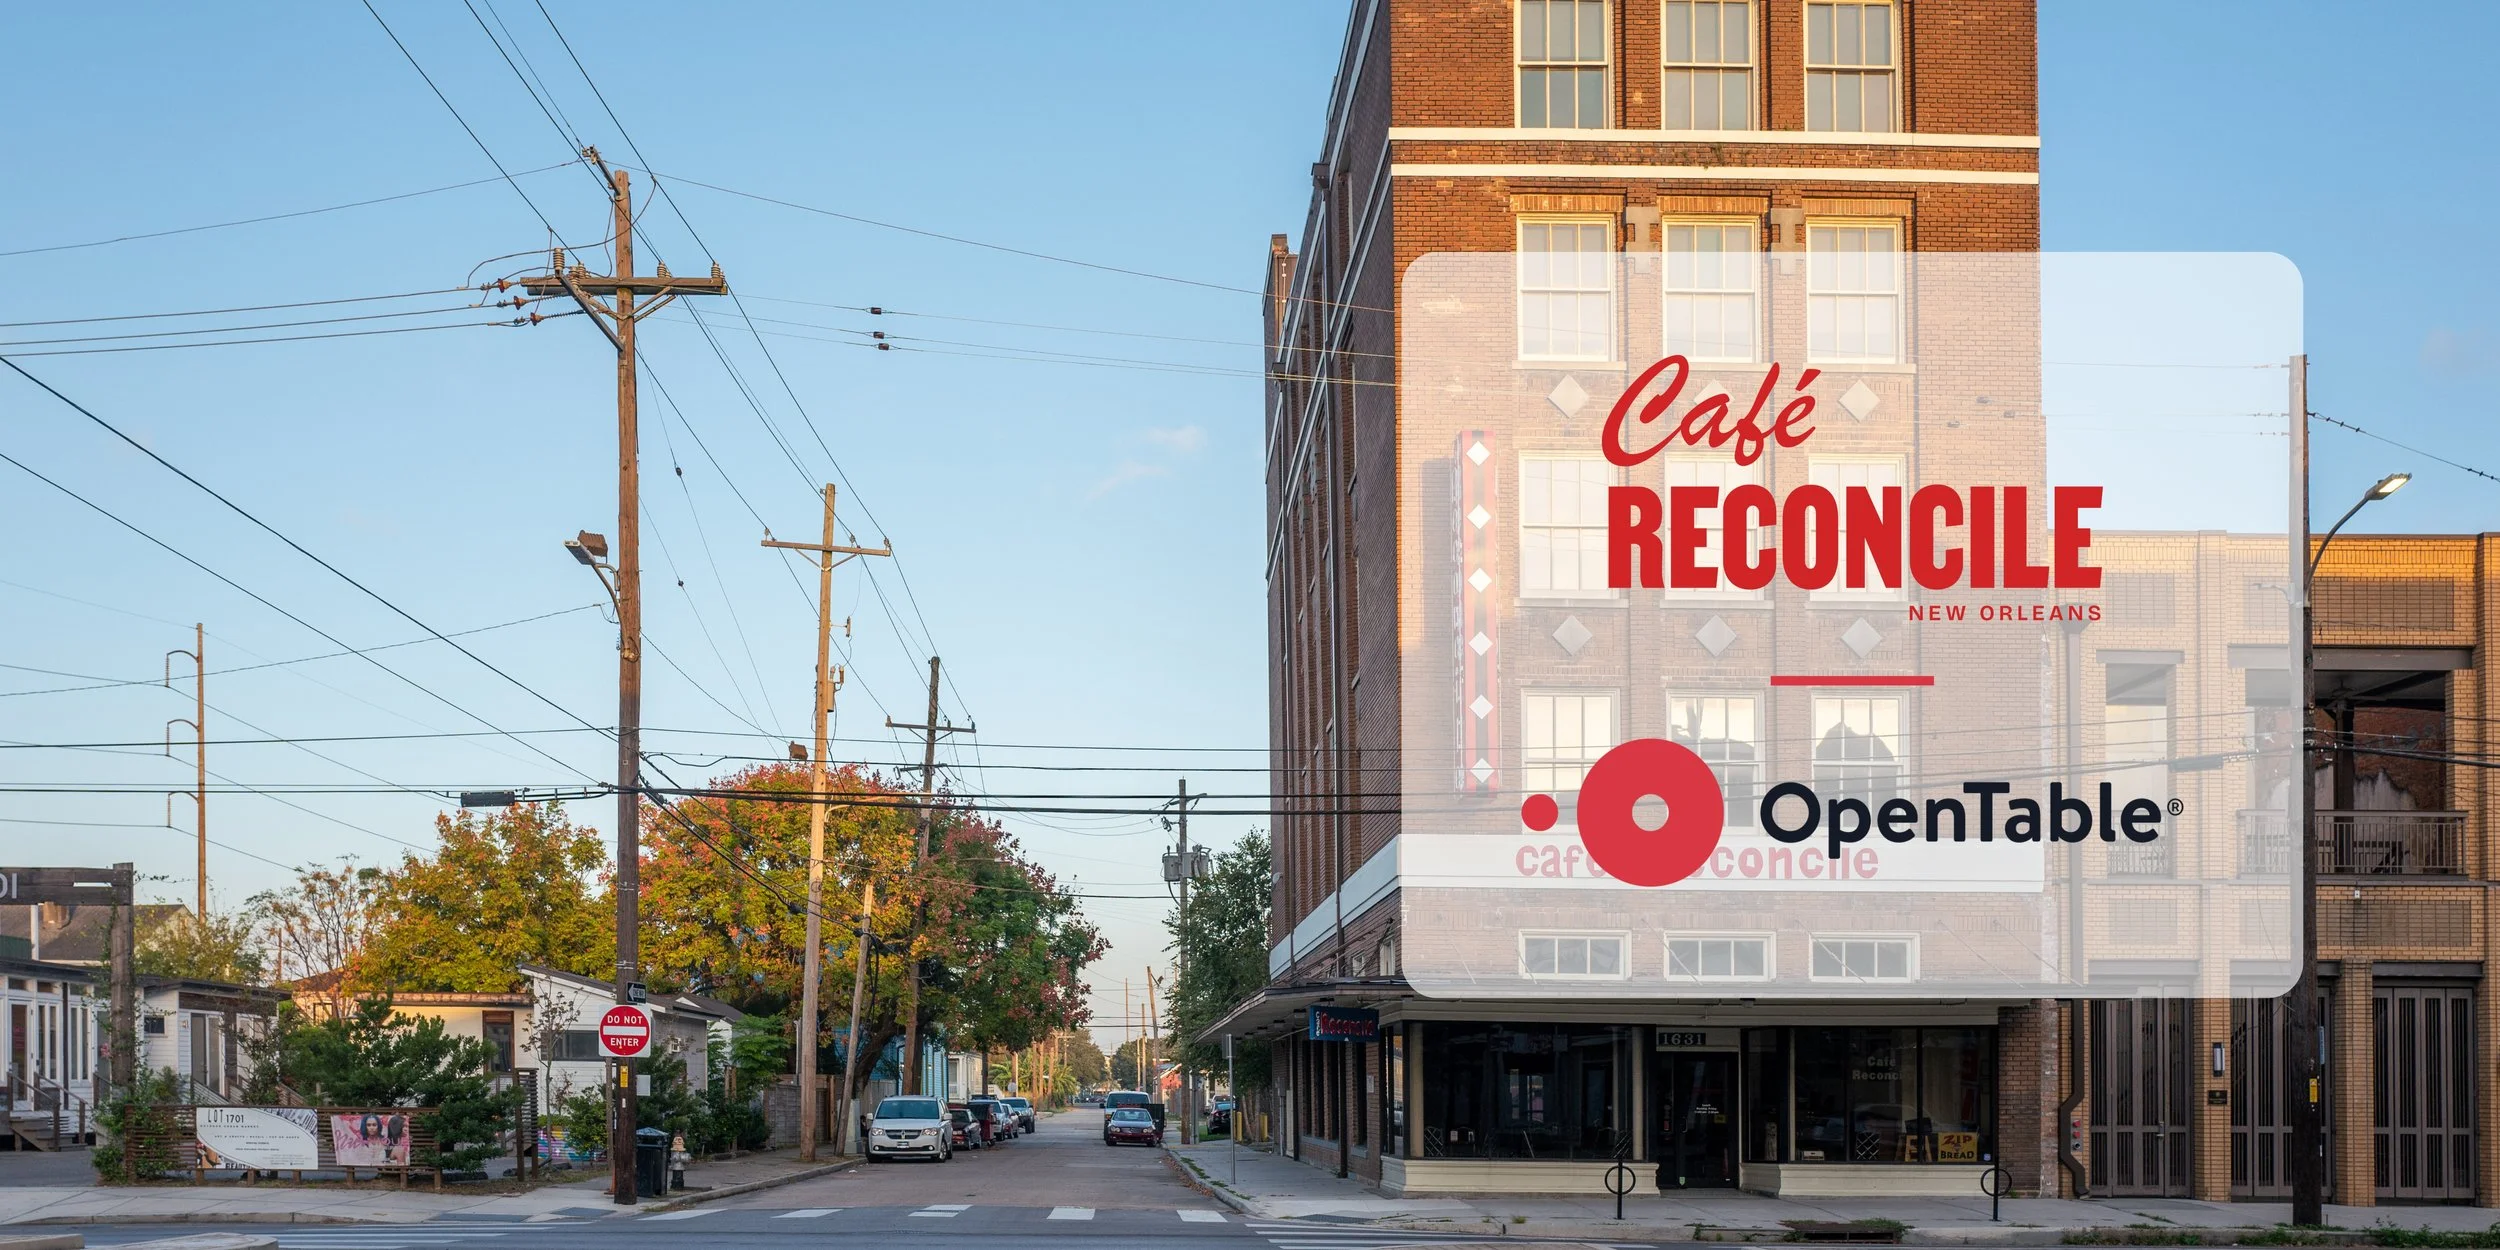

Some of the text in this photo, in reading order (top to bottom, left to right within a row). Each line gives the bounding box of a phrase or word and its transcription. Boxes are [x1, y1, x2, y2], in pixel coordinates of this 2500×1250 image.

[1687, 847, 1879, 880] concile
[607, 1015, 643, 1025] DO NOT
[610, 1037, 639, 1047] ENTER
[1663, 1033, 1702, 1046] 1631
[208, 1109, 244, 1123] LOT 1701
[1942, 1134, 1972, 1146] ZIP
[1940, 1150, 1974, 1159] BREAD
